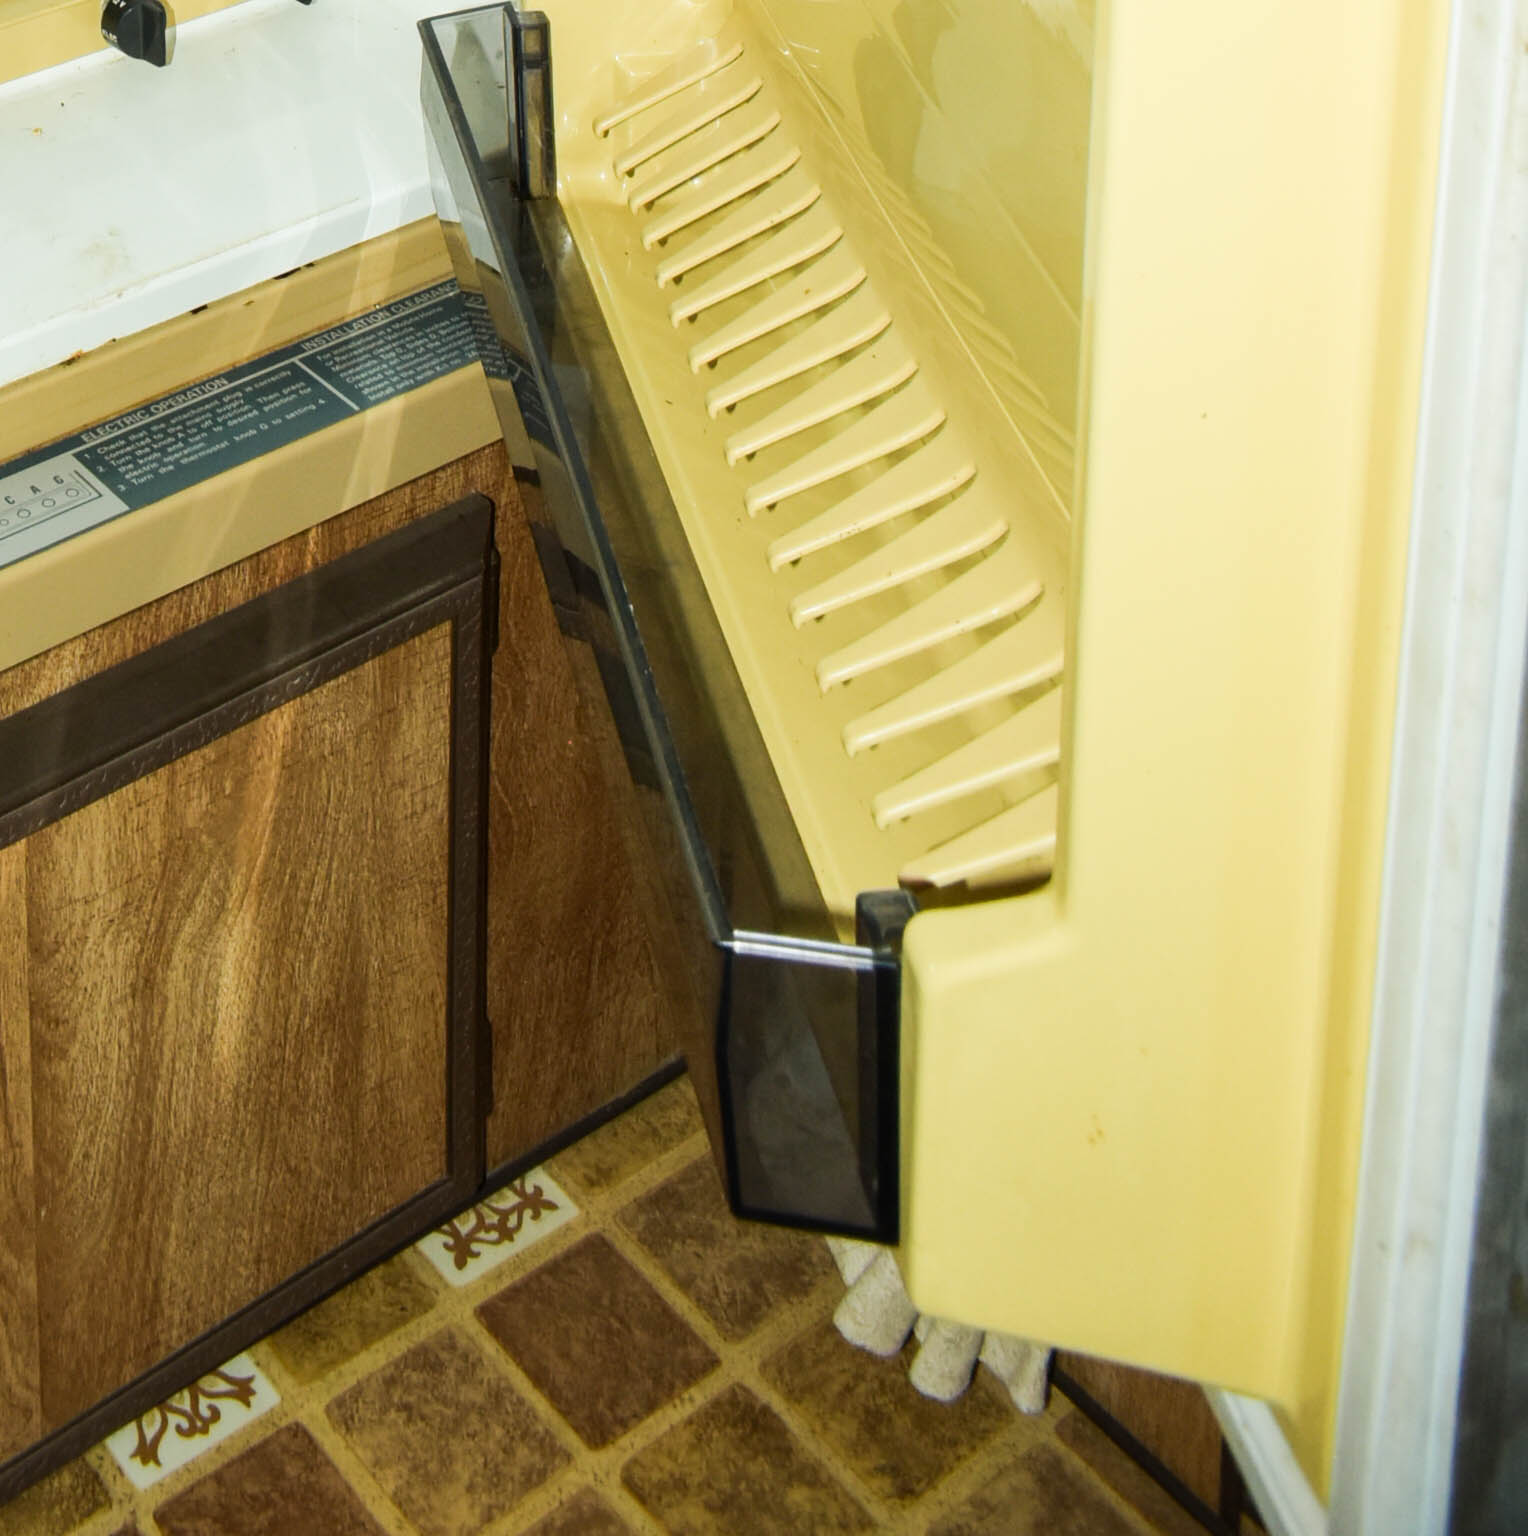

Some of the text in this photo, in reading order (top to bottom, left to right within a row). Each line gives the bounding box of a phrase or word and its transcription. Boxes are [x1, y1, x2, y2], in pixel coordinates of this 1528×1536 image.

[301, 308, 390, 352] INSTALLATION
[80, 375, 230, 444] ELECTRIC OPERATION
[4, 495, 16, 505] C
[30, 485, 41, 495] A
[53, 475, 64, 485] G
